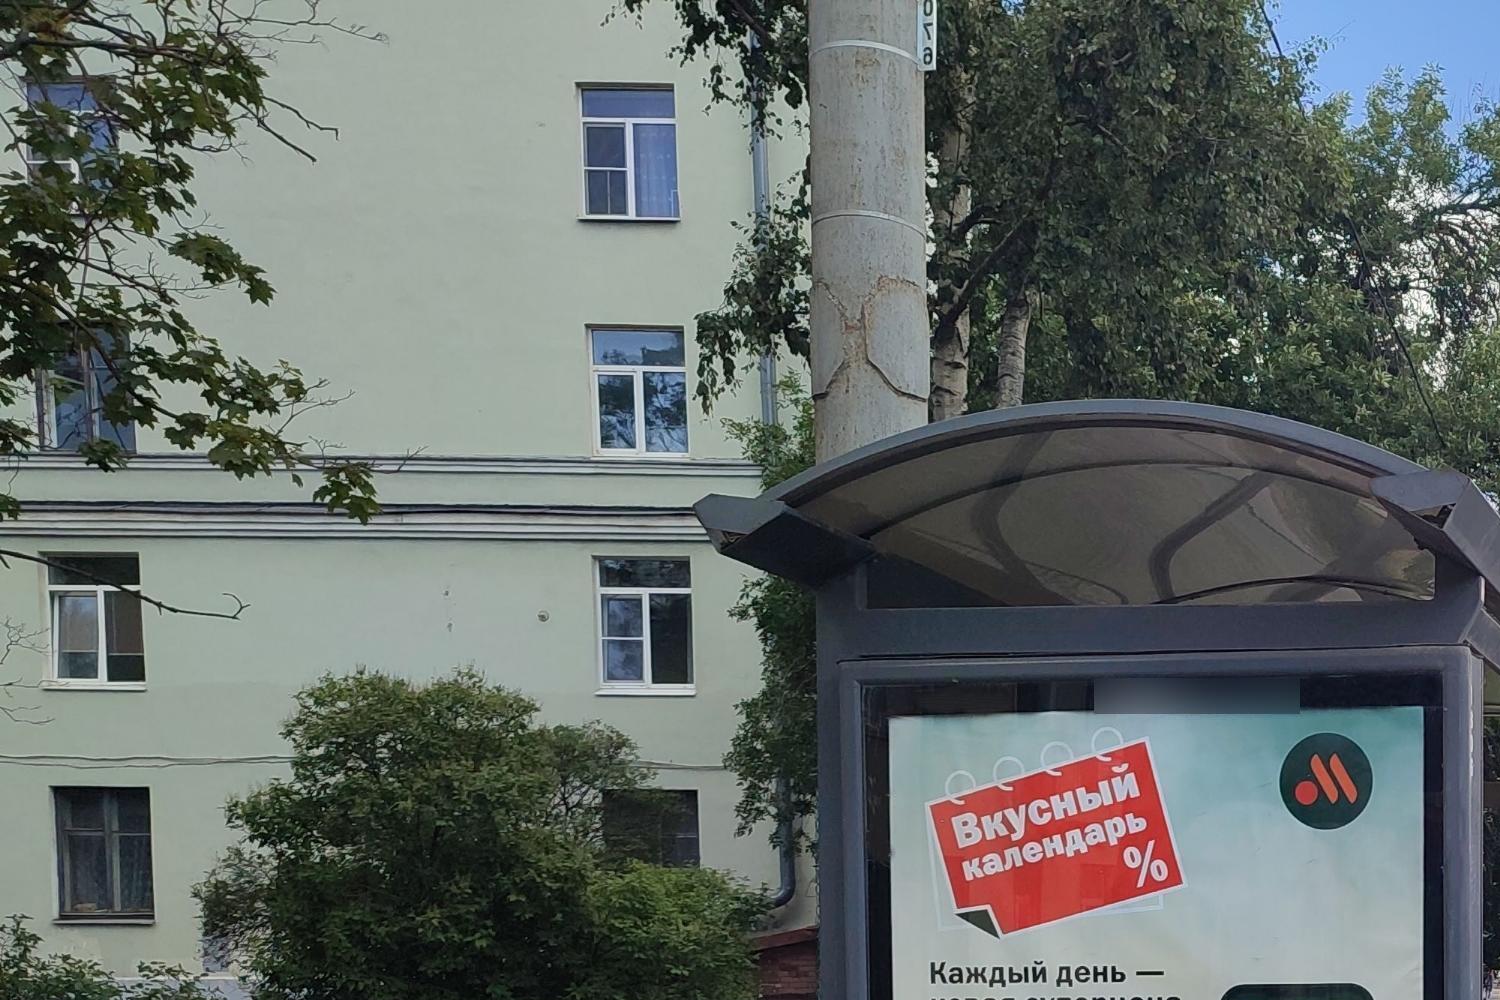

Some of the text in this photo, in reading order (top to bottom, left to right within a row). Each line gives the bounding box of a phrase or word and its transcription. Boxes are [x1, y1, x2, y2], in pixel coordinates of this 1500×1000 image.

[951, 763, 1140, 849] Вкусный
[962, 813, 1147, 881] календарь
[1123, 840, 1169, 888] %
[930, 961, 1048, 987] Каждый
[1056, 965, 1126, 987] день
